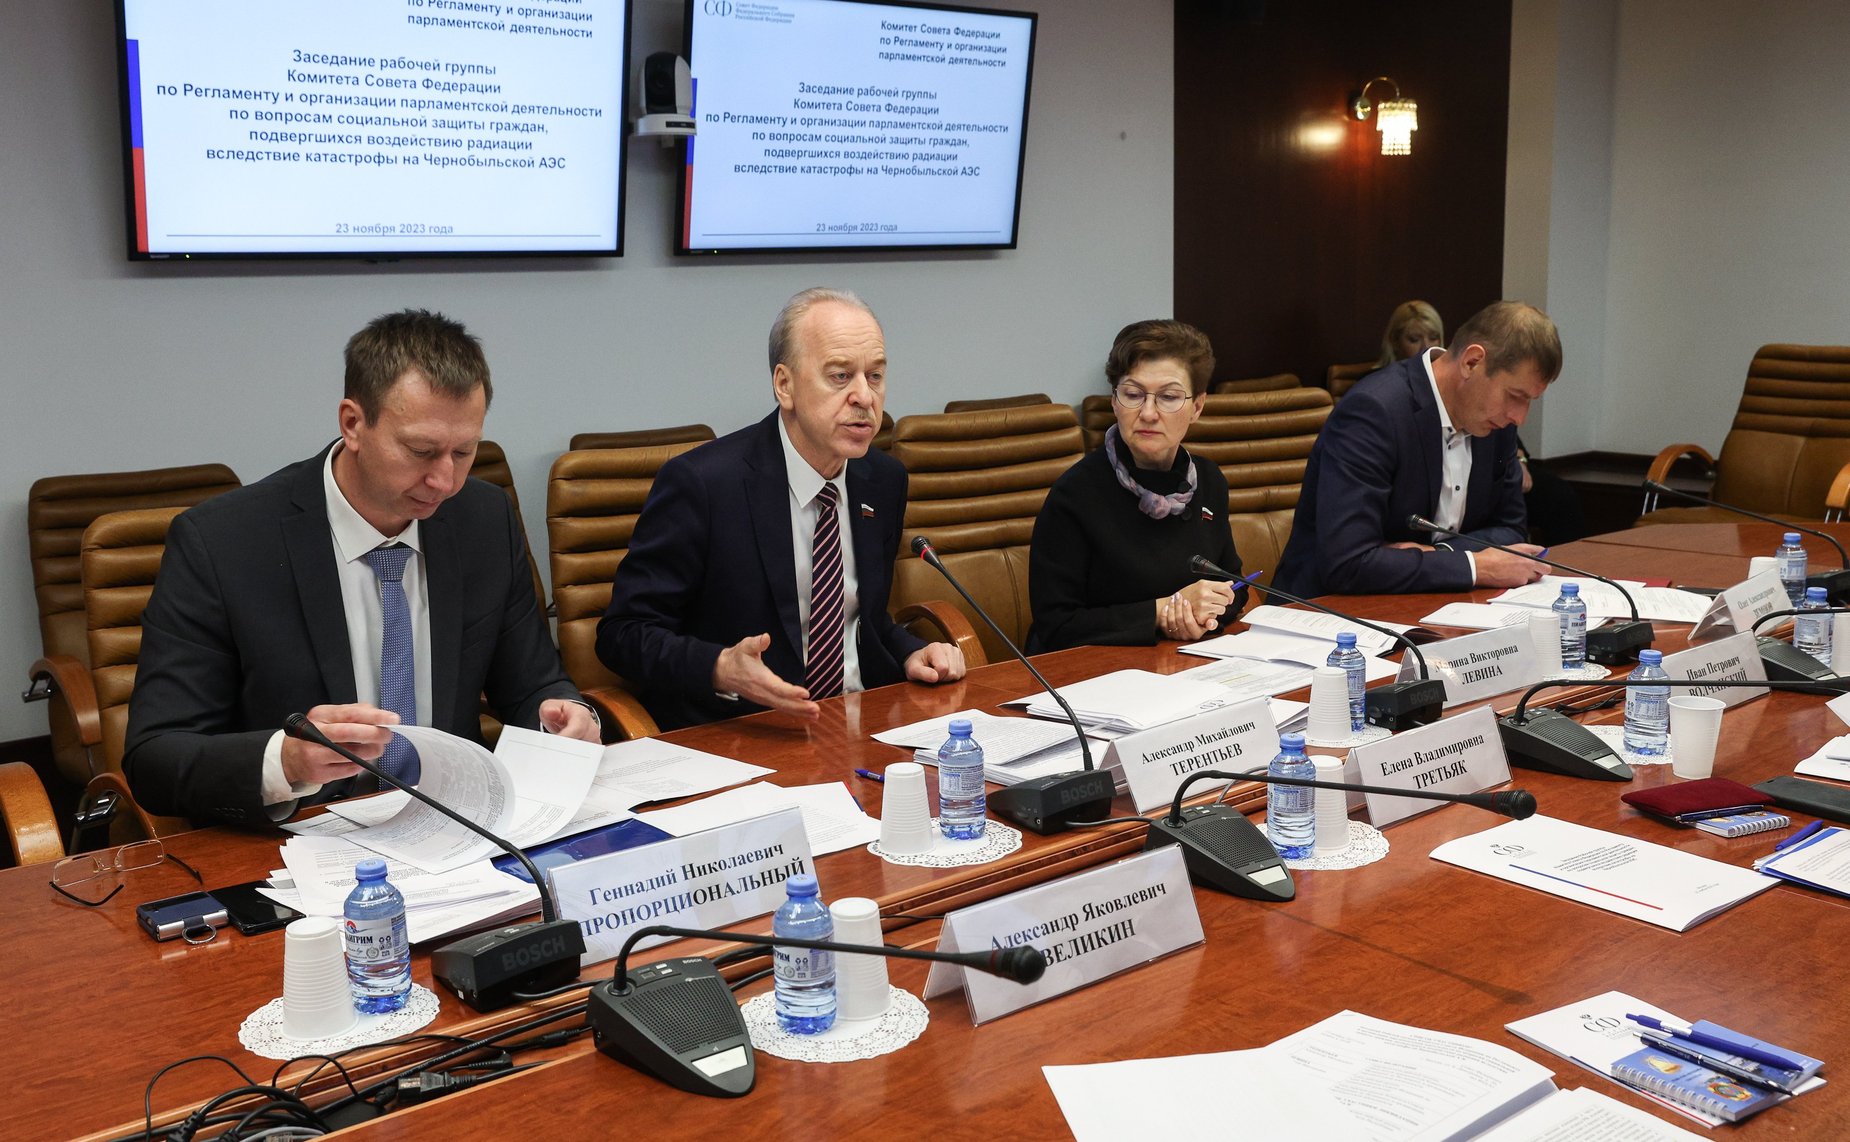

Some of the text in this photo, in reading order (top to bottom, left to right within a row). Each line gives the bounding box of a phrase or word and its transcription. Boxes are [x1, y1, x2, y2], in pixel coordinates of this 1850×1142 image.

[428, 0, 502, 17] Регламенту
[506, 6, 513, 15] и
[517, 7, 592, 22] организации
[408, 15, 592, 38] парламентской деятельности
[881, 20, 1001, 39] Комитет Совета Федерации
[880, 37, 891, 45] по
[893, 36, 944, 52] Регламенту
[954, 43, 1007, 54] организации
[293, 49, 496, 76] Заседание рабочей группы
[879, 52, 1006, 67] парламентской деятельности
[287, 69, 501, 95] Комитета Совета Федерации
[798, 82, 937, 101] Заседание рабочей группы
[157, 83, 602, 117] по Регламенту и организации парламентской деятельности
[793, 98, 939, 116] Комитета Совета Федерации
[229, 109, 548, 134] по вопросам социальной защиты граждан,
[706, 112, 1008, 133] по Регламенту и организации парламентской деятельности
[249, 131, 532, 151] подвергшихся воздействию радиации
[752, 132, 969, 148] по вопросам социальной защиты граждан,
[206, 149, 566, 169] вследствие катастрофы на Чернобыльской АЭС
[764, 149, 958, 163] подвергшихся воздействию радиации
[734, 164, 980, 177] вследствие катастрофы на Чернобыльской АЭС
[336, 222, 454, 236] 23 ноября 2023 года
[816, 222, 898, 233] 23 ноября 2023 года
[1470, 645, 1518, 664] Викторовна
[1462, 665, 1503, 685] ЛЕВИНА
[1686, 656, 1740, 681] Иван Петрович
[1142, 721, 1256, 764] Александр Михайлович
[1170, 743, 1243, 776] ТЕРЕНТЬЕВ
[1381, 734, 1484, 776] Елена Владимировна
[1413, 760, 1468, 789] ТРЕТЬЯК
[589, 844, 784, 905] Геннадий Николаевич
[578, 857, 805, 937] ПРОПОРЦИОНАЛЬНЫЙ
[992, 883, 1167, 950] Александр Яковлевич
[502, 936, 566, 971] BOSCH
[1040, 919, 1136, 967] ВЕЛИКИН
